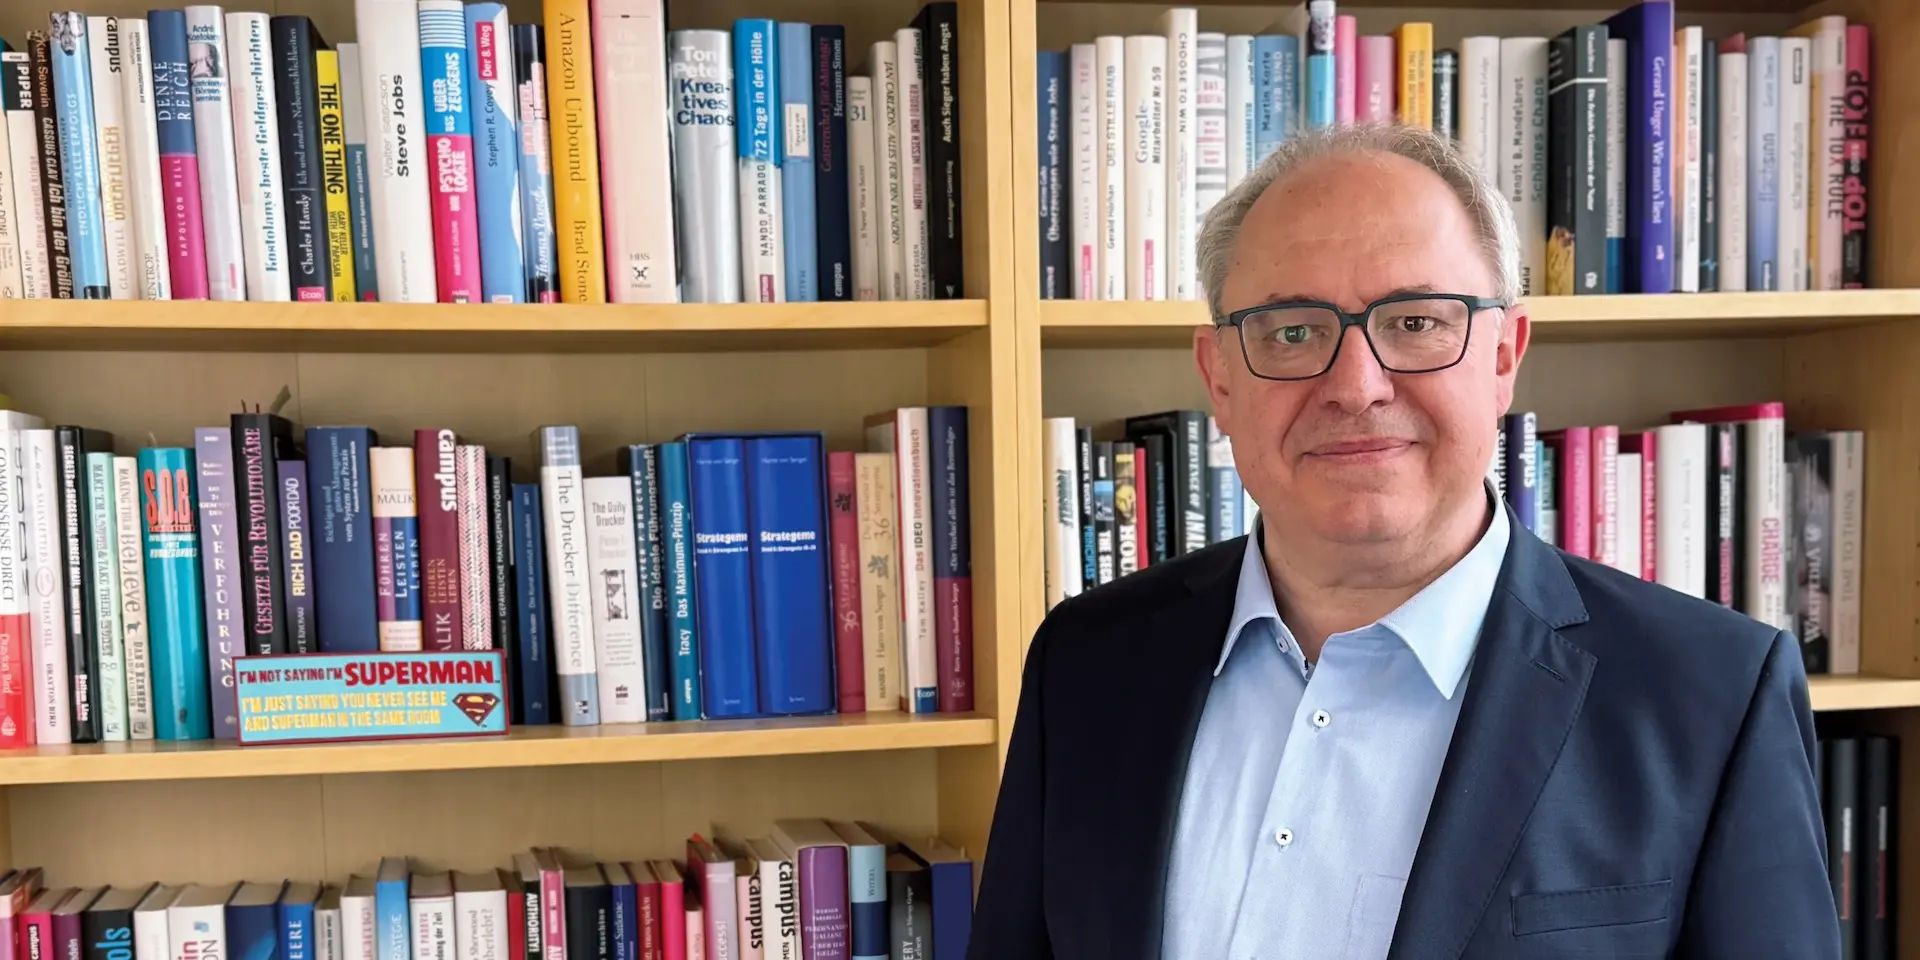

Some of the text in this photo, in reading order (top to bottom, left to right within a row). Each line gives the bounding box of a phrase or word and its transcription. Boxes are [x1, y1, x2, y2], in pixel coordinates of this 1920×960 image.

[106, 17, 121, 73] campus
[17, 63, 32, 108] PIPER
[154, 61, 172, 121] DENKE
[175, 61, 192, 121] REICH
[250, 20, 268, 144] Geldgeschichten
[445, 52, 462, 112] ZEUGENS
[559, 13, 585, 182] Amazon Unbound
[680, 79, 731, 93] Krea-
[683, 95, 728, 110] tives
[750, 31, 768, 157] 72 Tage in der Hölle
[833, 39, 843, 117] Hermann Simon
[940, 22, 953, 142] Auch Sieger haben Angst
[1178, 32, 1187, 134] CHOOSE TO WIN
[1260, 51, 1271, 131] Martin Korte
[1649, 56, 1665, 137] Gerard Unger
[43, 118, 56, 156] CASSIUS
[291, 120, 305, 148] andere
[319, 84, 344, 194] THE ONE THING
[392, 75, 409, 177] Steve Jobs
[483, 84, 500, 167] Stephen R. Covey
[676, 110, 735, 126] Chaos
[850, 105, 867, 121] 31
[1531, 77, 1544, 202] Schönes Chaos
[48, 157, 59, 180] CLAY
[71, 152, 82, 178] ALLE
[294, 151, 306, 168] und
[296, 169, 307, 185] Ich
[436, 138, 452, 193] PSYCHO
[451, 151, 468, 193] LOGIE
[1046, 78, 1061, 242] Überzeugen wie Steve Jobs
[1107, 142, 1115, 167] DER
[1652, 140, 1665, 164] Wie
[1828, 95, 1845, 218] THE 10X RULE
[51, 207, 65, 228] bin
[74, 183, 89, 236] ENDLICH
[297, 194, 314, 275] Charles Handy
[337, 211, 348, 256] GARY KELLER
[757, 165, 769, 256] NANDO PARRADO
[1652, 201, 1664, 224] liest
[53, 230, 68, 254] der
[328, 211, 340, 277] WITH JAY PAPASAN
[573, 219, 590, 301] Brad Stone
[834, 262, 844, 297] campus
[434, 429, 457, 512] campus
[1519, 411, 1537, 488] campus
[143, 468, 195, 525] S.O.B.
[322, 485, 333, 503] und
[340, 449, 354, 542] vom System zur Praxis
[557, 471, 573, 503] The
[592, 501, 626, 514] The Daily
[910, 428, 924, 571] Das IDEO Innovationsbuch
[243, 428, 273, 634] GESETZE FÜR REVOLUTIONÄRE
[286, 477, 305, 596] RICH DAD POOR DAD
[560, 510, 576, 577] Drucker
[596, 515, 625, 527] Drucker
[696, 532, 748, 544] Strategeme
[760, 531, 816, 543] Strategeme
[1155, 504, 1166, 552] Keynes
[379, 532, 391, 596] FÜHREN
[394, 530, 408, 597] LEISTEN
[1084, 525, 1095, 580] PRINCIPLES
[1761, 517, 1780, 584] CHARGE
[1841, 541, 1856, 563] TO
[448, 568, 458, 603] LEBEN
[671, 502, 691, 656] Tracy Das Maximum-Prinzip
[565, 582, 584, 668] Difference
[840, 610, 858, 633] 36
[876, 615, 884, 631] von
[876, 632, 885, 658] Harro
[46, 663, 57, 727] DRAYTON BIRD
[240, 660, 494, 686] I'M NOT SAYING I'M SUPERMAN
[242, 690, 448, 713] I'M JUST SAYING YOU NEVER SEE ME
[244, 715, 271, 732] AND
[271, 713, 335, 731] SUPERMAN
[349, 712, 373, 727] THE
[374, 710, 407, 726] SAME
[526, 892, 540, 953] AUTHORITY!
[748, 872, 764, 949] campus
[775, 861, 795, 937] campus
[29, 925, 38, 960] campus
